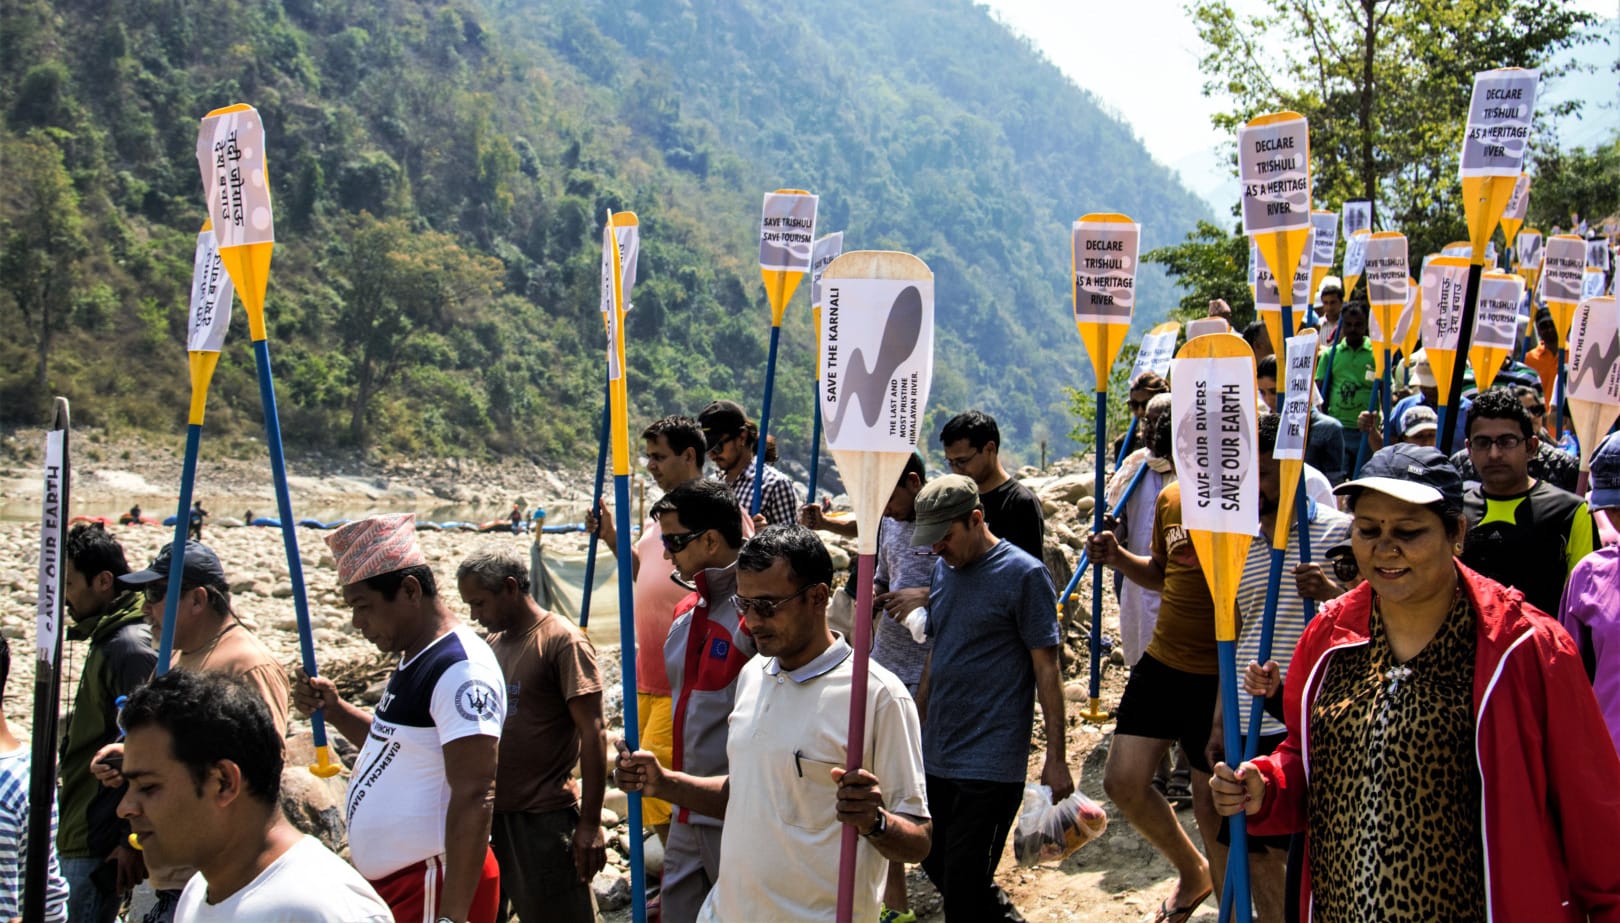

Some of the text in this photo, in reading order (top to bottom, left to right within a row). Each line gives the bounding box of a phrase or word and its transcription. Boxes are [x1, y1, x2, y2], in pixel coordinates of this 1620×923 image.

[1486, 89, 1522, 100] DECLARE
[1469, 126, 1527, 139] AS A HERITAGE
[227, 129, 242, 161] नदी
[1255, 137, 1294, 153] DECLARE
[214, 140, 226, 168] देश
[1256, 158, 1295, 174] TRISHULI
[1245, 177, 1306, 197] AS A HERITAGE
[1267, 202, 1291, 216] RIVER
[764, 217, 812, 228] SAVE TRISHULI
[763, 232, 811, 243] SAVE TOURISM
[1086, 240, 1123, 251] DECLARE
[1085, 258, 1122, 269] TRISHULI
[1366, 257, 1405, 267] SAVE TRISHULI
[1560, 258, 1584, 268] TRISHULI
[1258, 271, 1267, 281] AS
[1380, 271, 1406, 279] TOURISM
[1559, 270, 1582, 280] TOURISM
[1086, 277, 1091, 286] A
[1094, 276, 1133, 288] HERITAGE
[1091, 294, 1113, 305] RIVER
[1489, 300, 1517, 310] TRISHULI
[1487, 313, 1515, 322] TOURISM
[1573, 354, 1581, 372] SAVE
[1580, 305, 1590, 337] KARNALI
[827, 288, 839, 402] SAVE THE KARNALI
[1195, 380, 1210, 508] SAVE OUR RIVERS
[1221, 384, 1240, 511] SAVE OUR EARTH
[46, 466, 59, 528] EARTH
[46, 537, 57, 578] OUR
